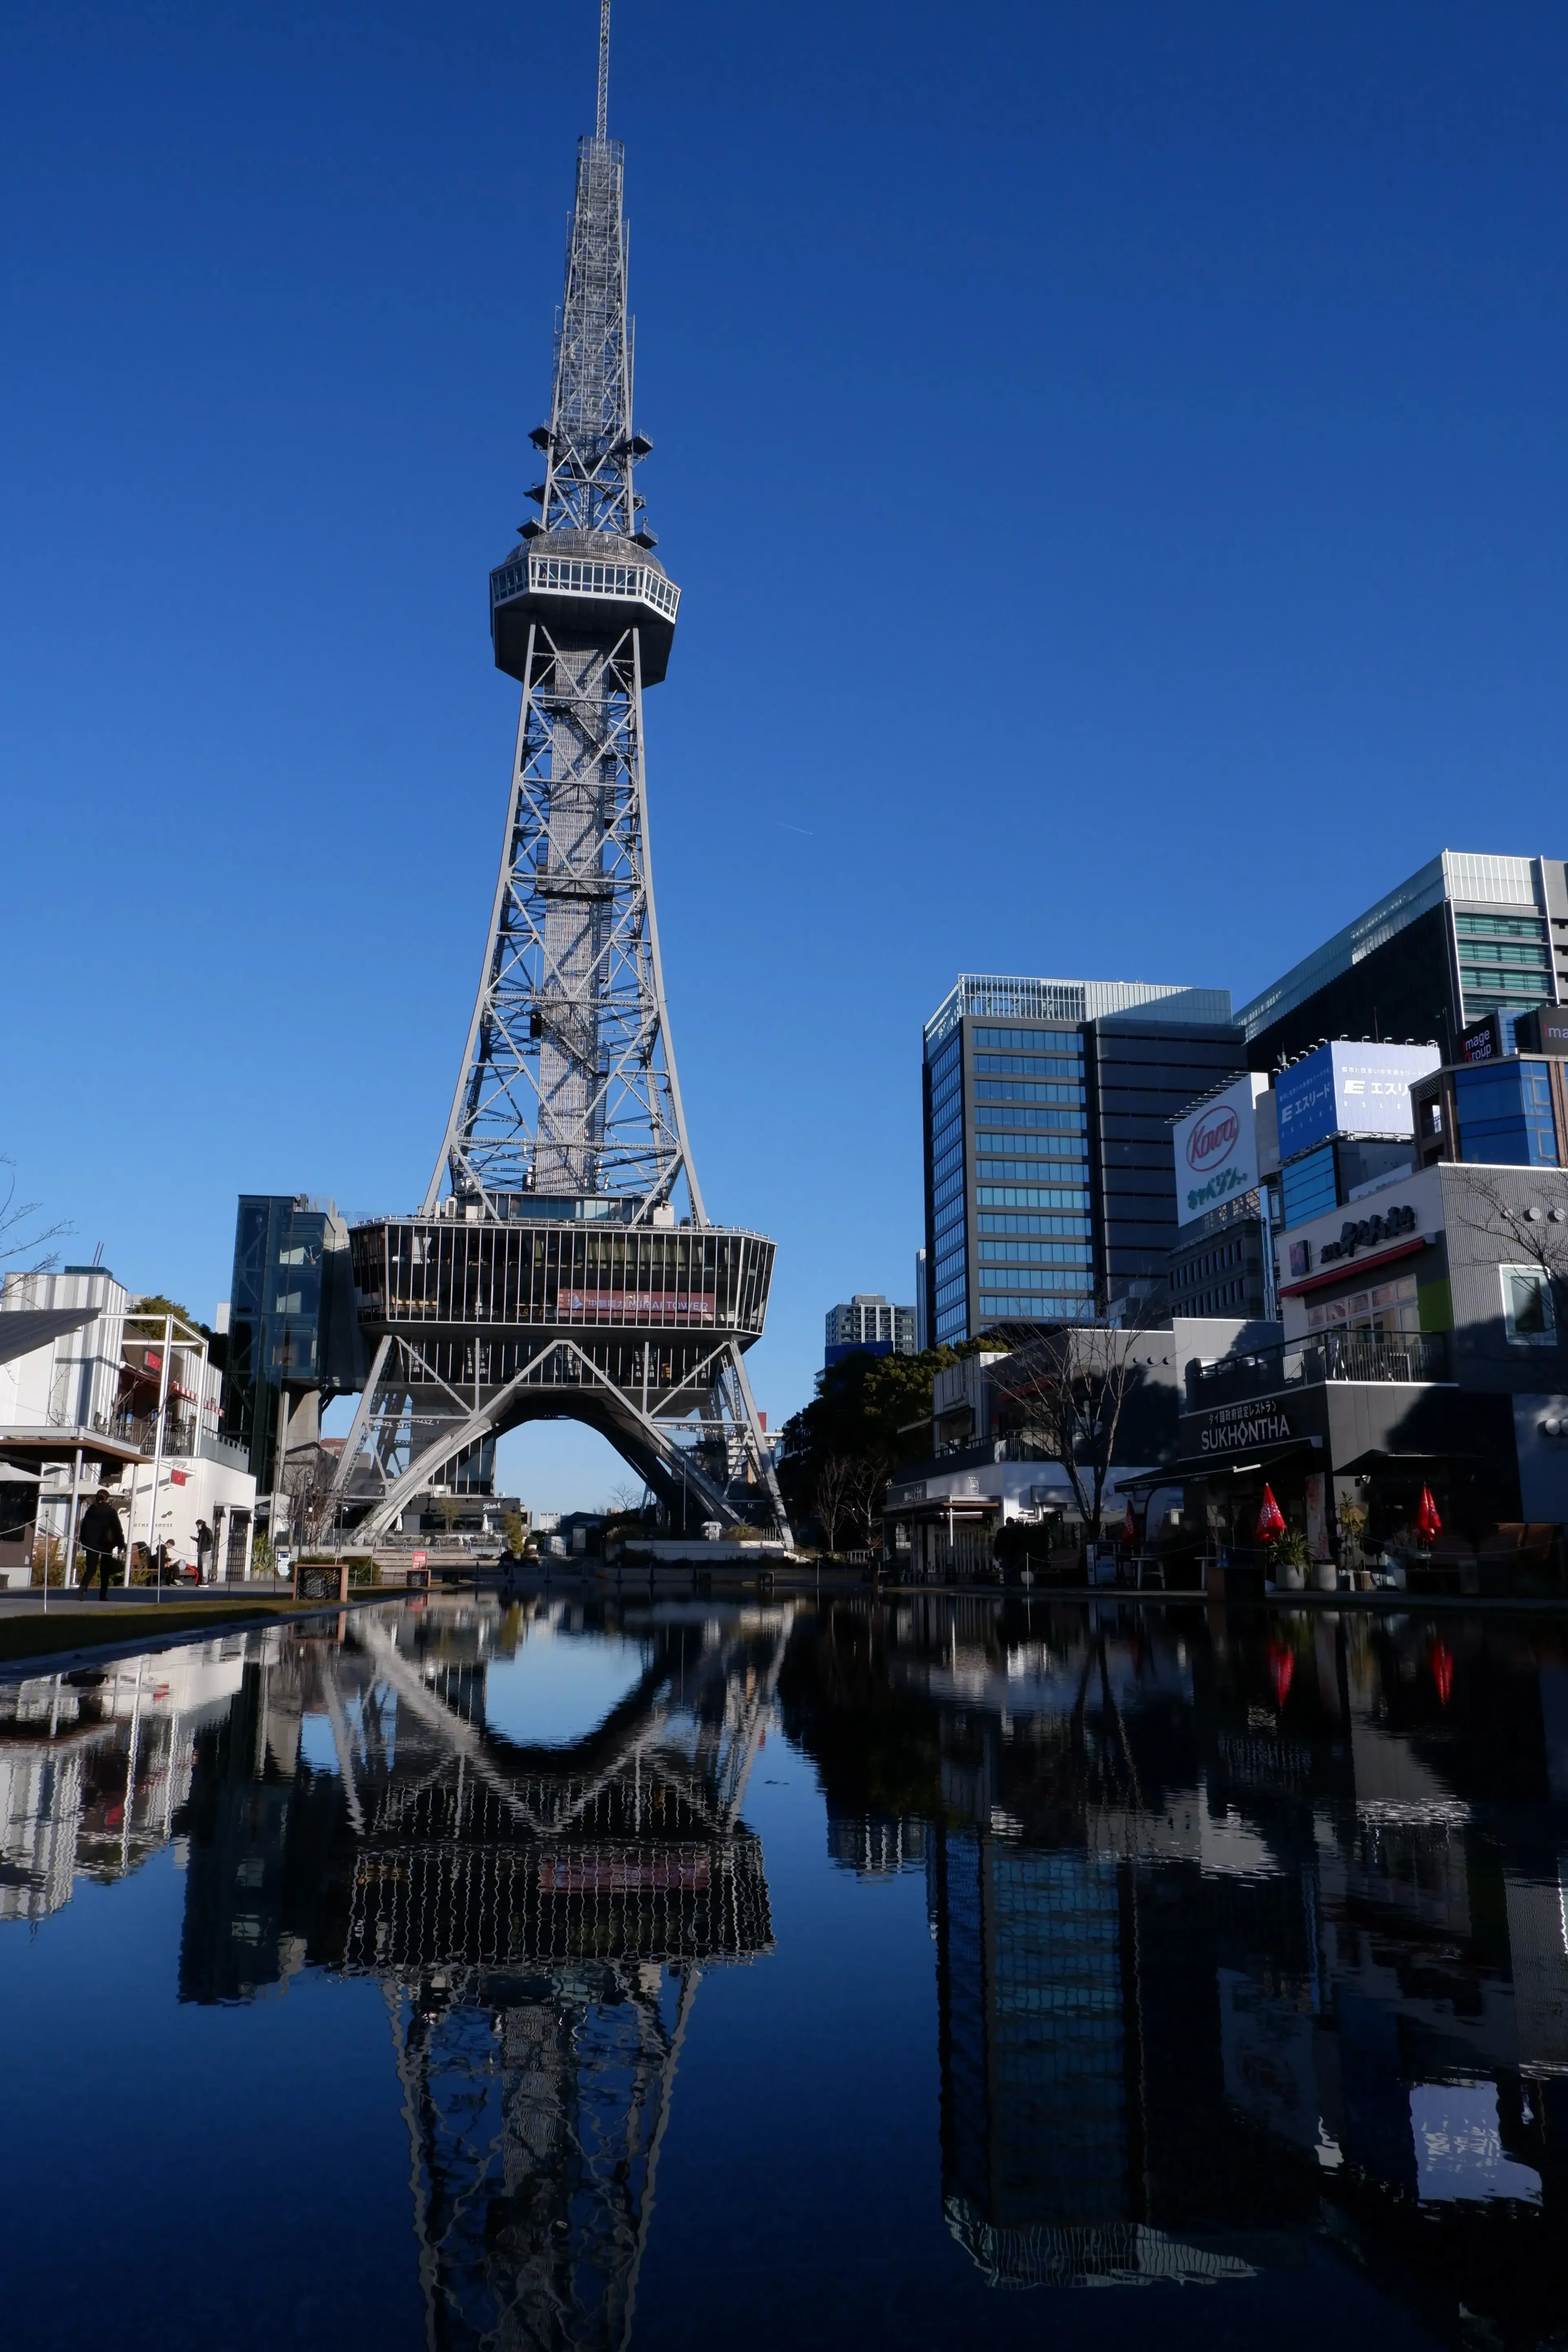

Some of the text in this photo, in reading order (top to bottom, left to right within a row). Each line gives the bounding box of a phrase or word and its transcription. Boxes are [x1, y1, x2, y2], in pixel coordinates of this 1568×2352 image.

[1463, 1029, 1490, 1052] Image
[1544, 1023, 1568, 1038] Ima
[1464, 1044, 1491, 1062] Group
[1295, 1082, 1330, 1115] エスリード
[1371, 1082, 1409, 1096] エスリ
[1344, 1101, 1401, 1109] ESLE
[1191, 1116, 1239, 1163] Kowa
[588, 1299, 708, 1311] 中部電力 MIRAI TOWER
[1209, 1400, 1276, 1425] タイ国政府認定レストラン
[1201, 1414, 1291, 1450] SUKHONTHA
